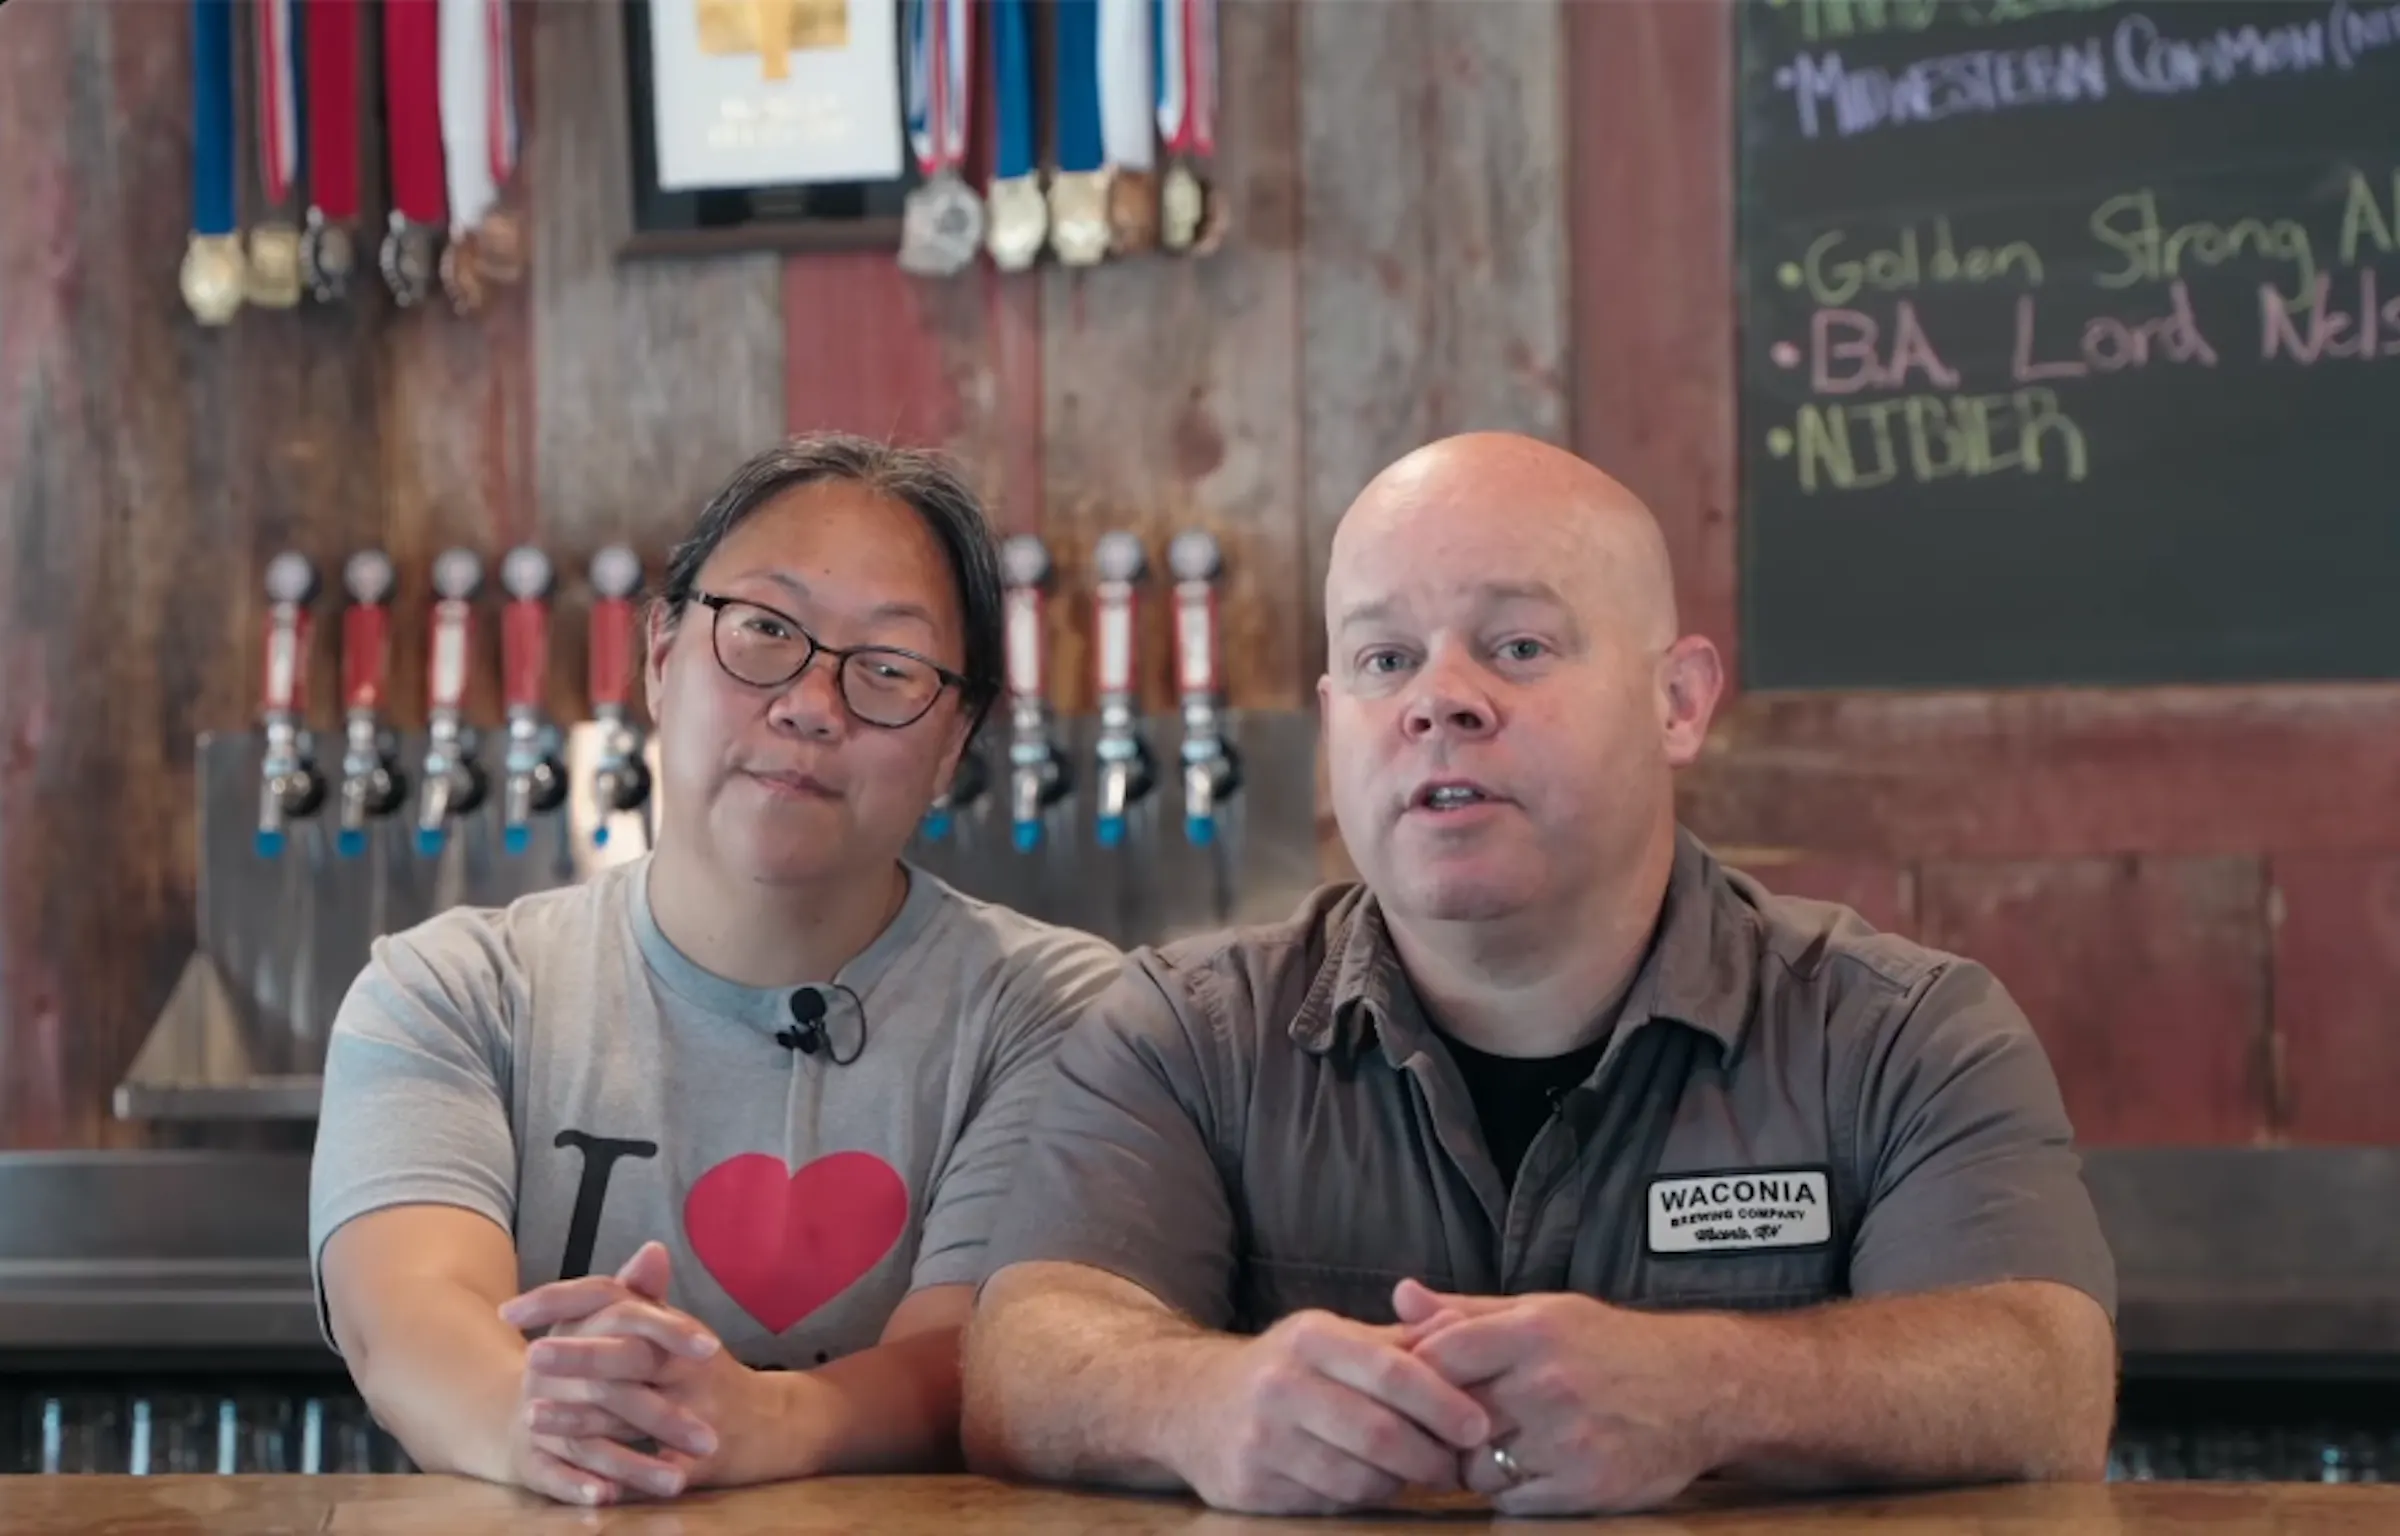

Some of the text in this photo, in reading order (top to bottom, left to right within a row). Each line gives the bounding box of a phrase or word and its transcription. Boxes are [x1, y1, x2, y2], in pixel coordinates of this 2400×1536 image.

[1804, 214, 2045, 306] Golden
[2089, 187, 2317, 314] Strong
[2011, 294, 2218, 382] Lord
[1661, 1180, 1817, 1213] WACONIA
[1671, 1207, 1806, 1228] BREWING COMPANY
